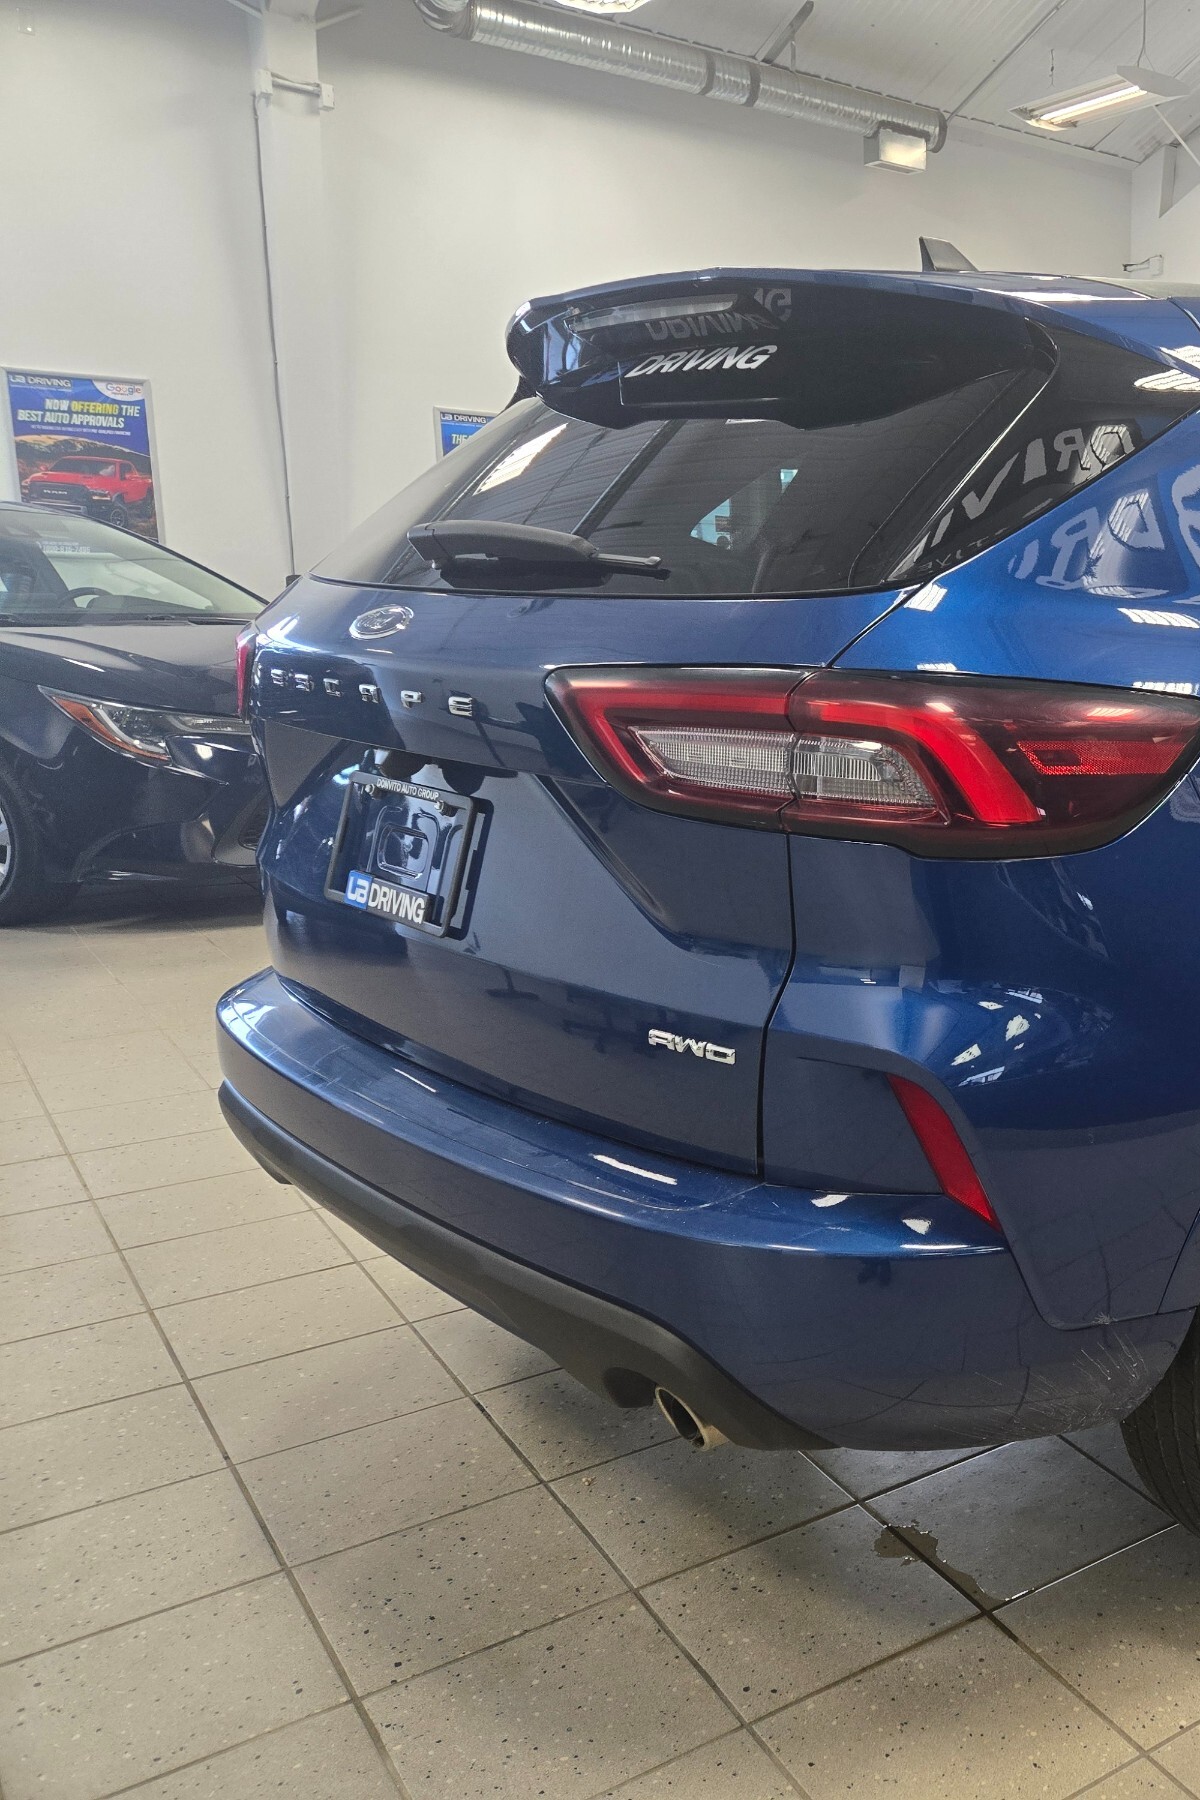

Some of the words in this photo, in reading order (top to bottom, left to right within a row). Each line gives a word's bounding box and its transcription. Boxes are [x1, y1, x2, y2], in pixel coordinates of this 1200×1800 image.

[624, 345, 778, 378] DRIVING
[28, 376, 72, 388] DRIVING
[106, 382, 142, 396] Google
[45, 398, 70, 411] NOW
[71, 400, 119, 415] OFFERING
[121, 404, 141, 417] THE
[17, 409, 43, 421] BEST
[44, 411, 69, 424] AUTO
[70, 413, 125, 428] APPROVALS
[454, 415, 486, 424] DRIVING
[376, 778, 401, 792] DONVITO
[401, 784, 417, 796] AUTO
[417, 787, 439, 801] GROUP
[367, 882, 425, 924] DRIVING
[648, 1028, 736, 1065] AWD
